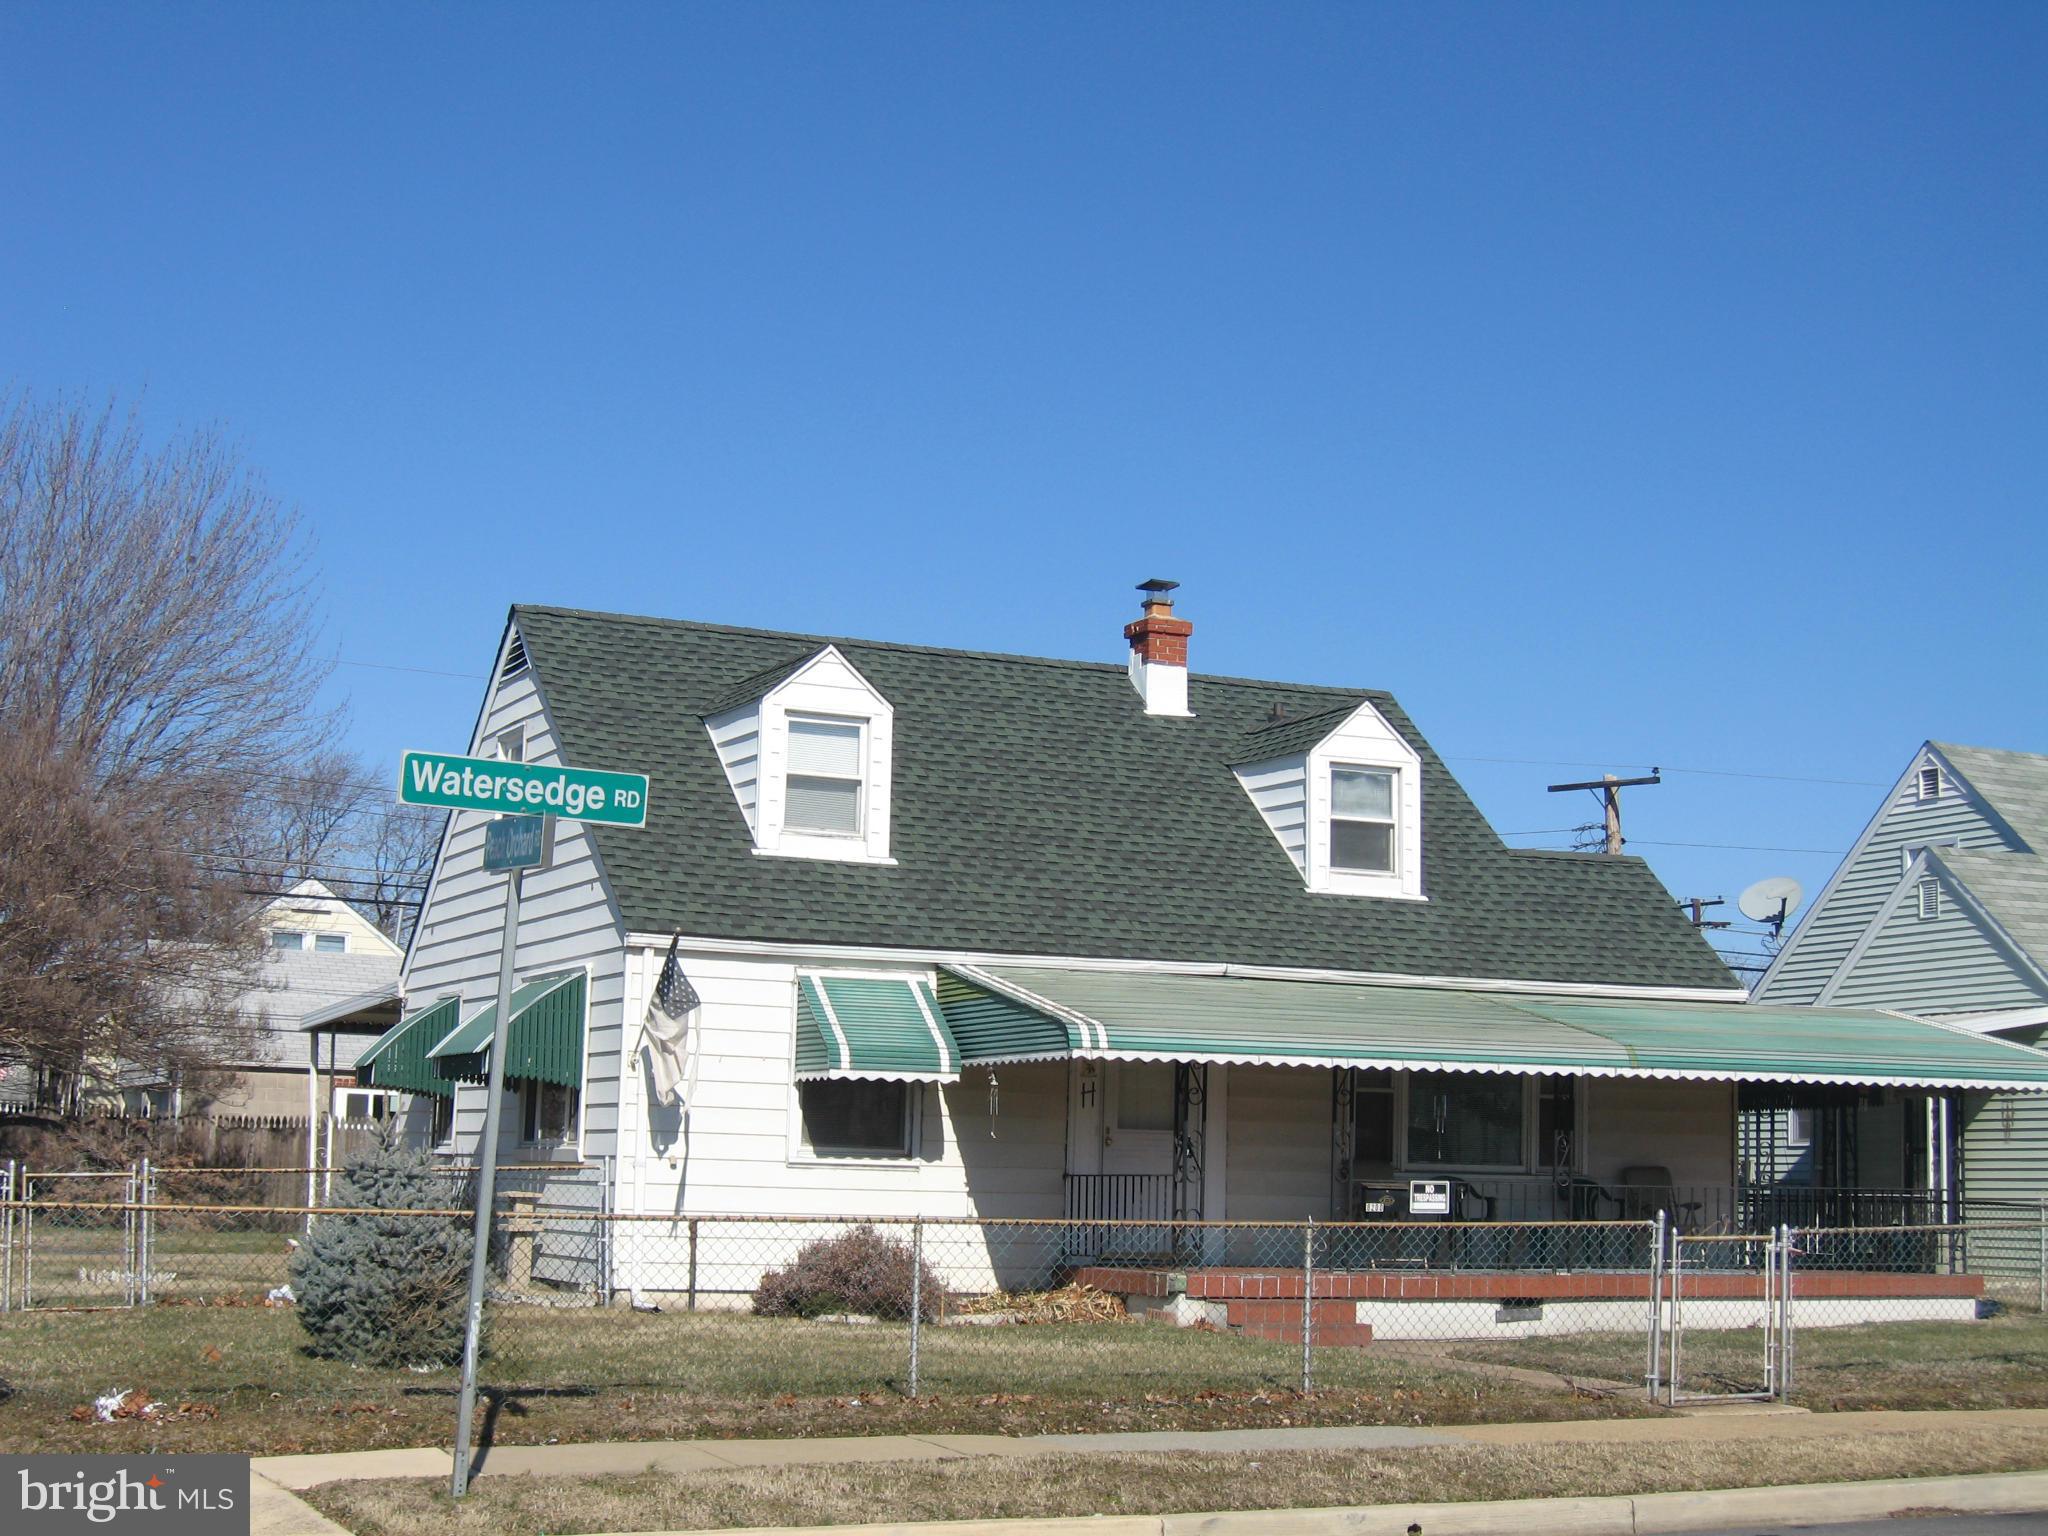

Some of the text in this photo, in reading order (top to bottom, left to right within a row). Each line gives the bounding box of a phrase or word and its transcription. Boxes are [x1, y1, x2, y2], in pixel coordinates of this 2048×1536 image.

[412, 759, 641, 815] Watersedge RD
[1425, 1184, 1435, 1194] NO
[1414, 1193, 1446, 1202] TRESPASSING
